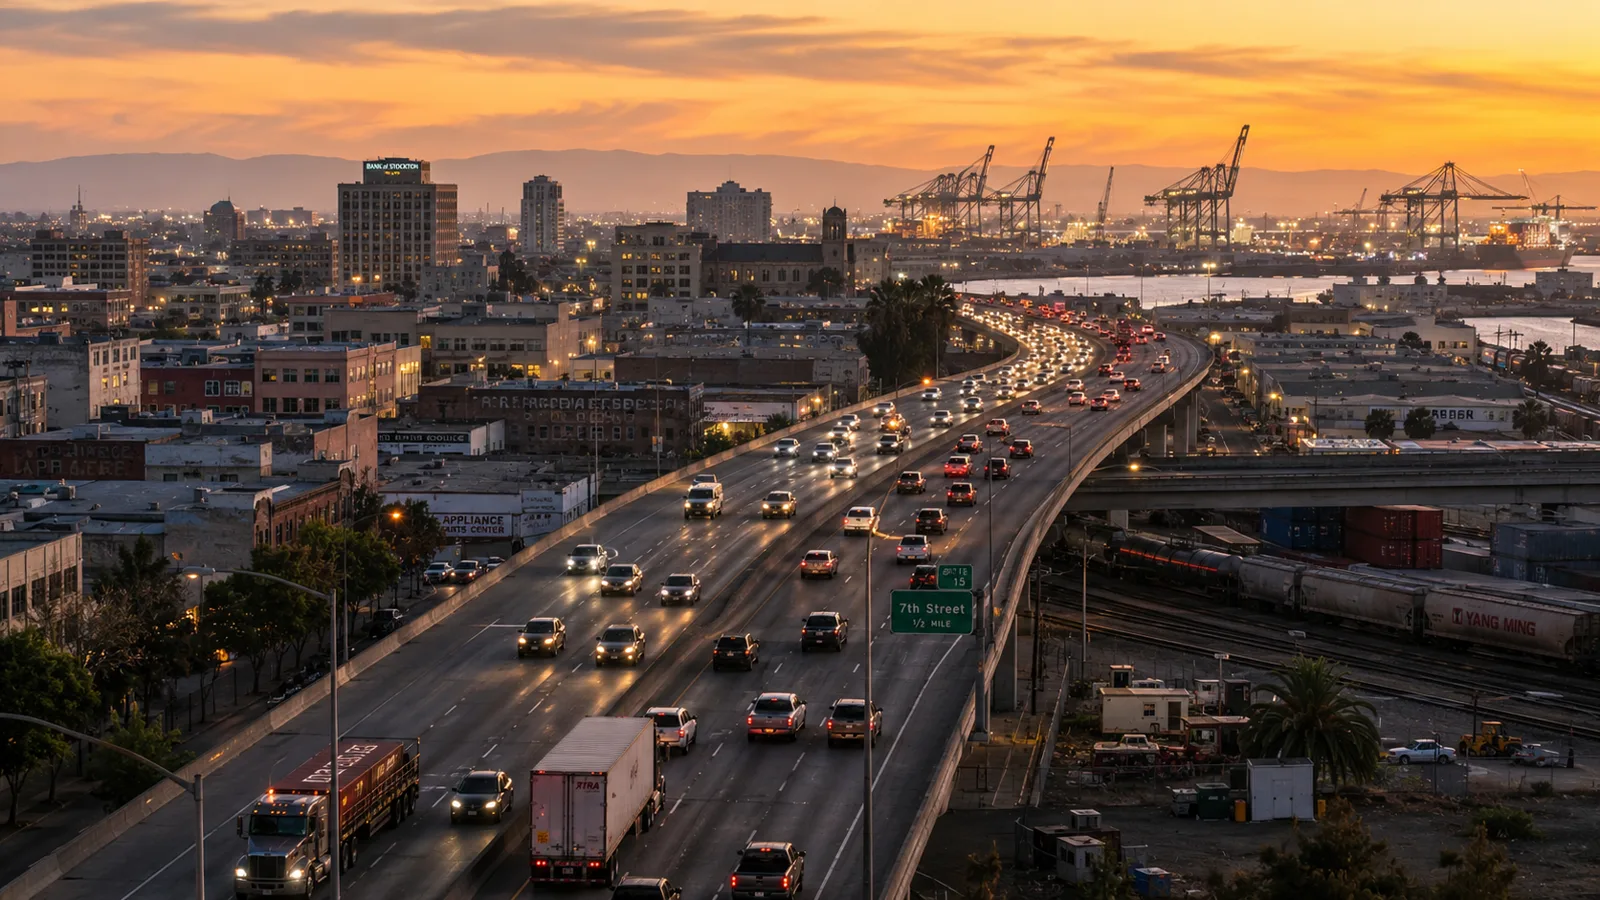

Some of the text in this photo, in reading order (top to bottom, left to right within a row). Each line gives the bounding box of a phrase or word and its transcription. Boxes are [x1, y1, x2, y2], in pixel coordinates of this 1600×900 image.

[442, 515, 505, 525] APPLIANCE
[470, 526, 505, 534] CENTER
[899, 603, 965, 615] 7th Street
[931, 620, 951, 628] MILE
[1466, 610, 1500, 631] YANG
[1503, 617, 1536, 637] MING
